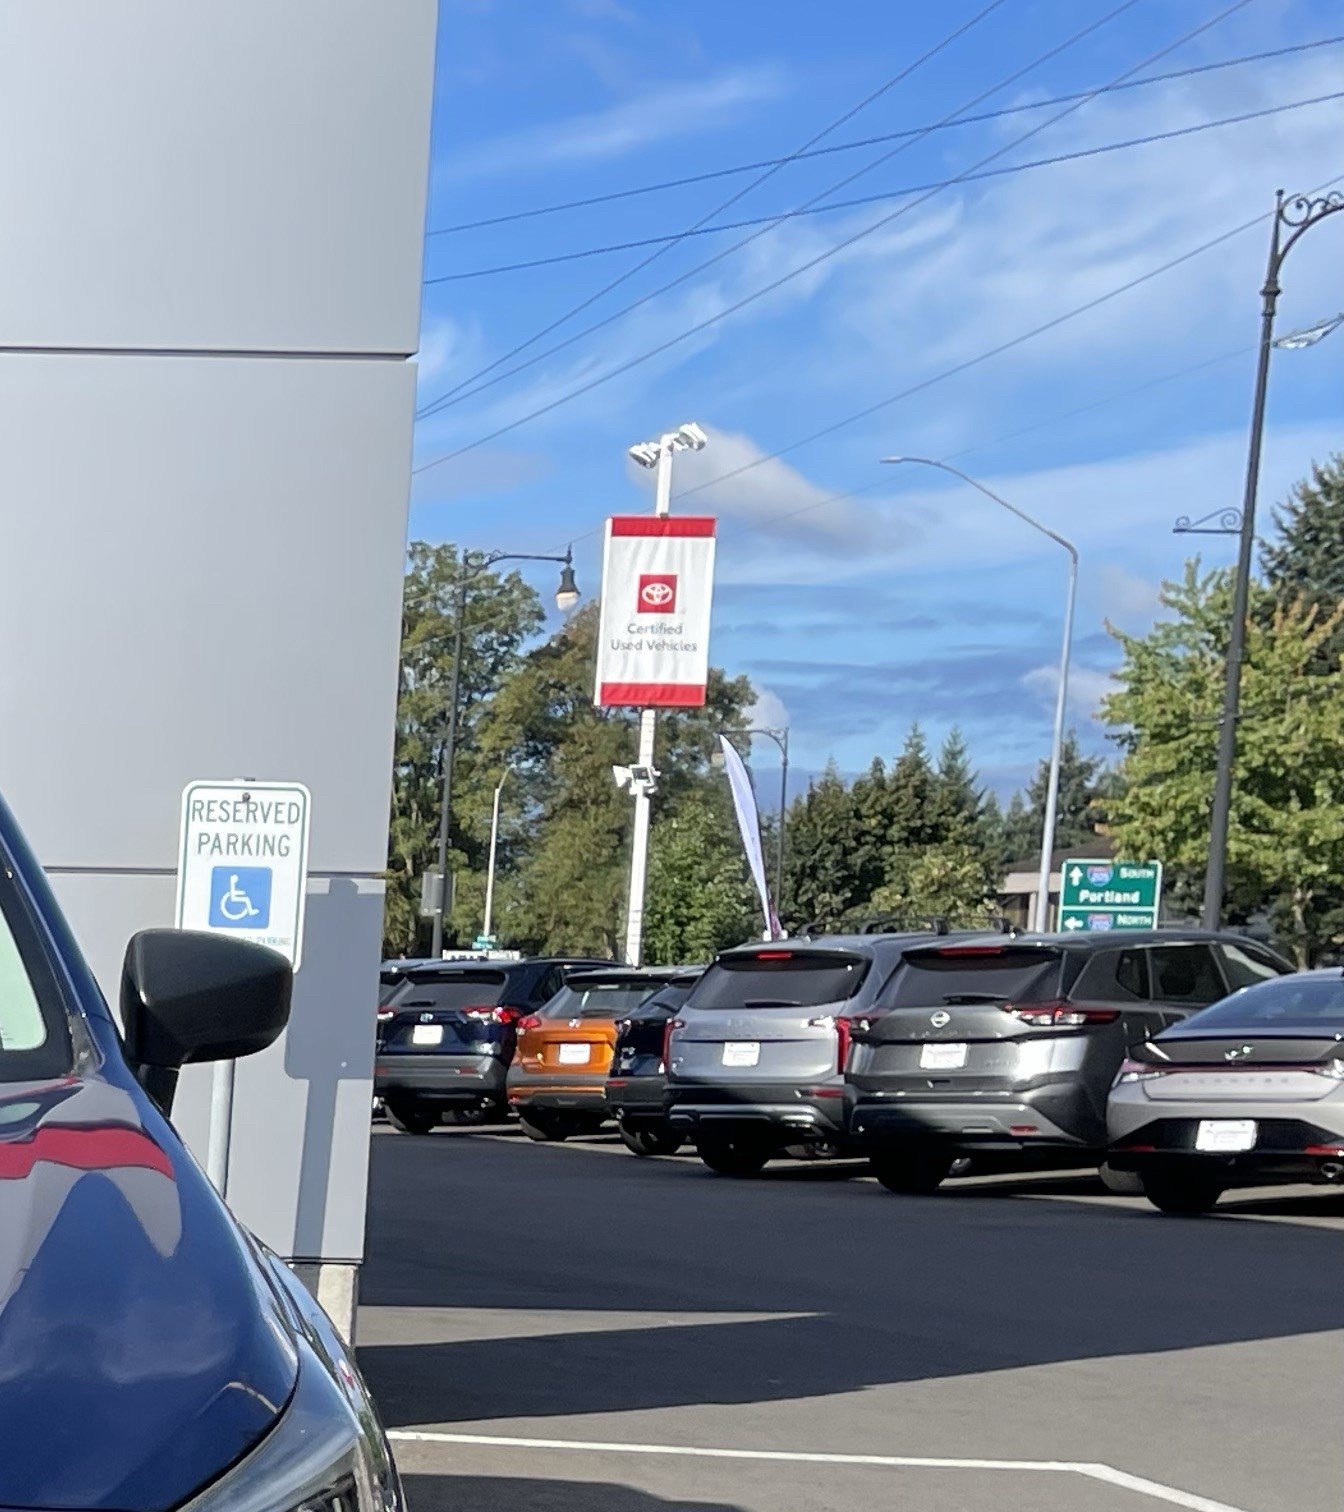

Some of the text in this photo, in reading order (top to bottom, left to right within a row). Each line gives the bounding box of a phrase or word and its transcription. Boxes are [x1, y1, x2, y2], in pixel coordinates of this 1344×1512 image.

[627, 622, 683, 635] Certified
[610, 638, 698, 653] Used Vehicles
[191, 799, 300, 824] RESERVED
[197, 832, 291, 857] PARKING
[1079, 889, 1141, 904] Portland
